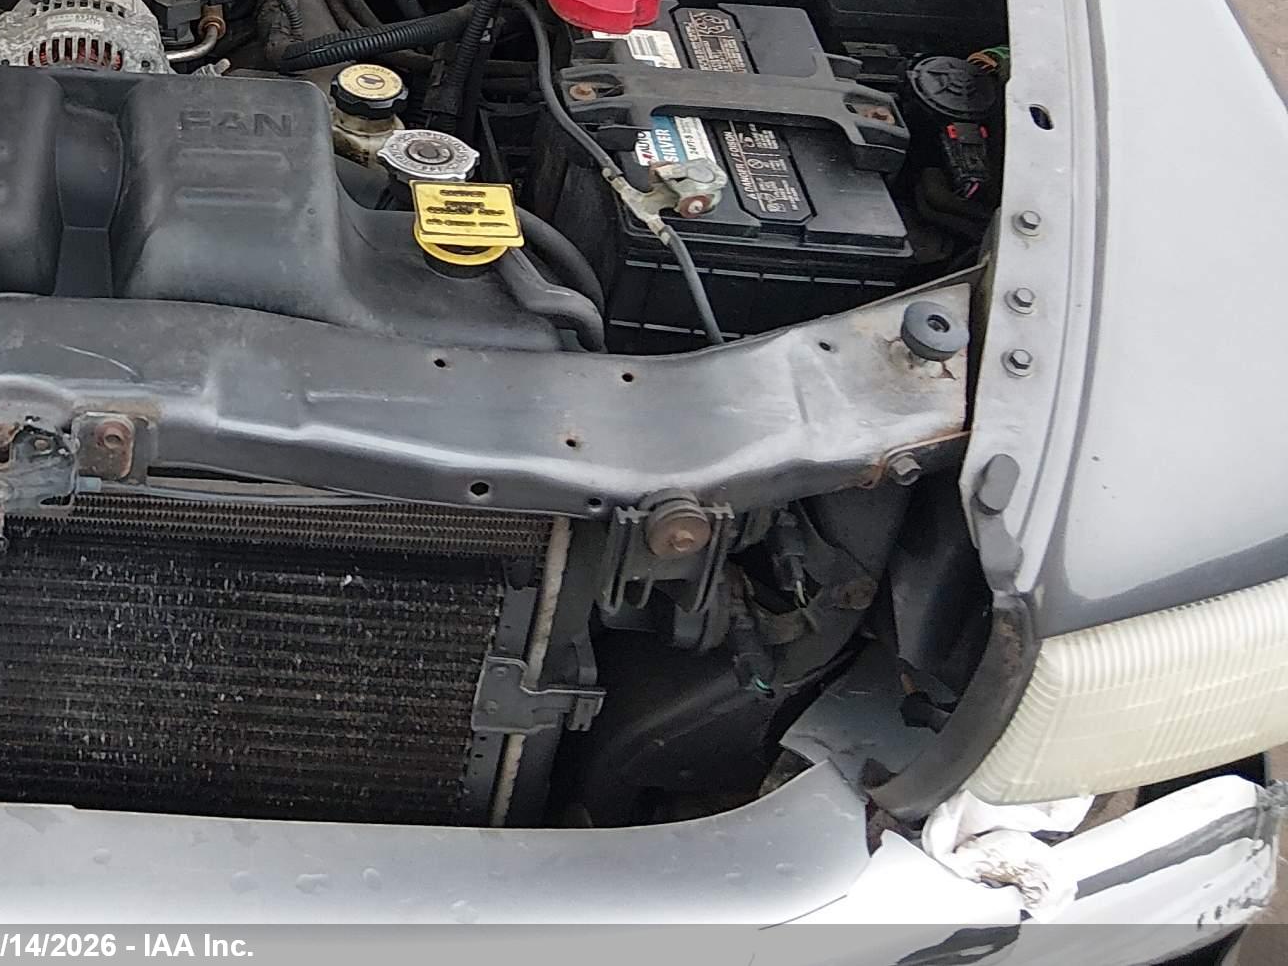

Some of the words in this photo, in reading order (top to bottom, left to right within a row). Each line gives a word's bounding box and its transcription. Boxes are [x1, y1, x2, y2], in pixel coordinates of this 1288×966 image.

[176, 111, 295, 137] FAN
[654, 129, 680, 162] SILVER
[723, 131, 741, 157] POISON
[735, 163, 755, 192] DANGER
